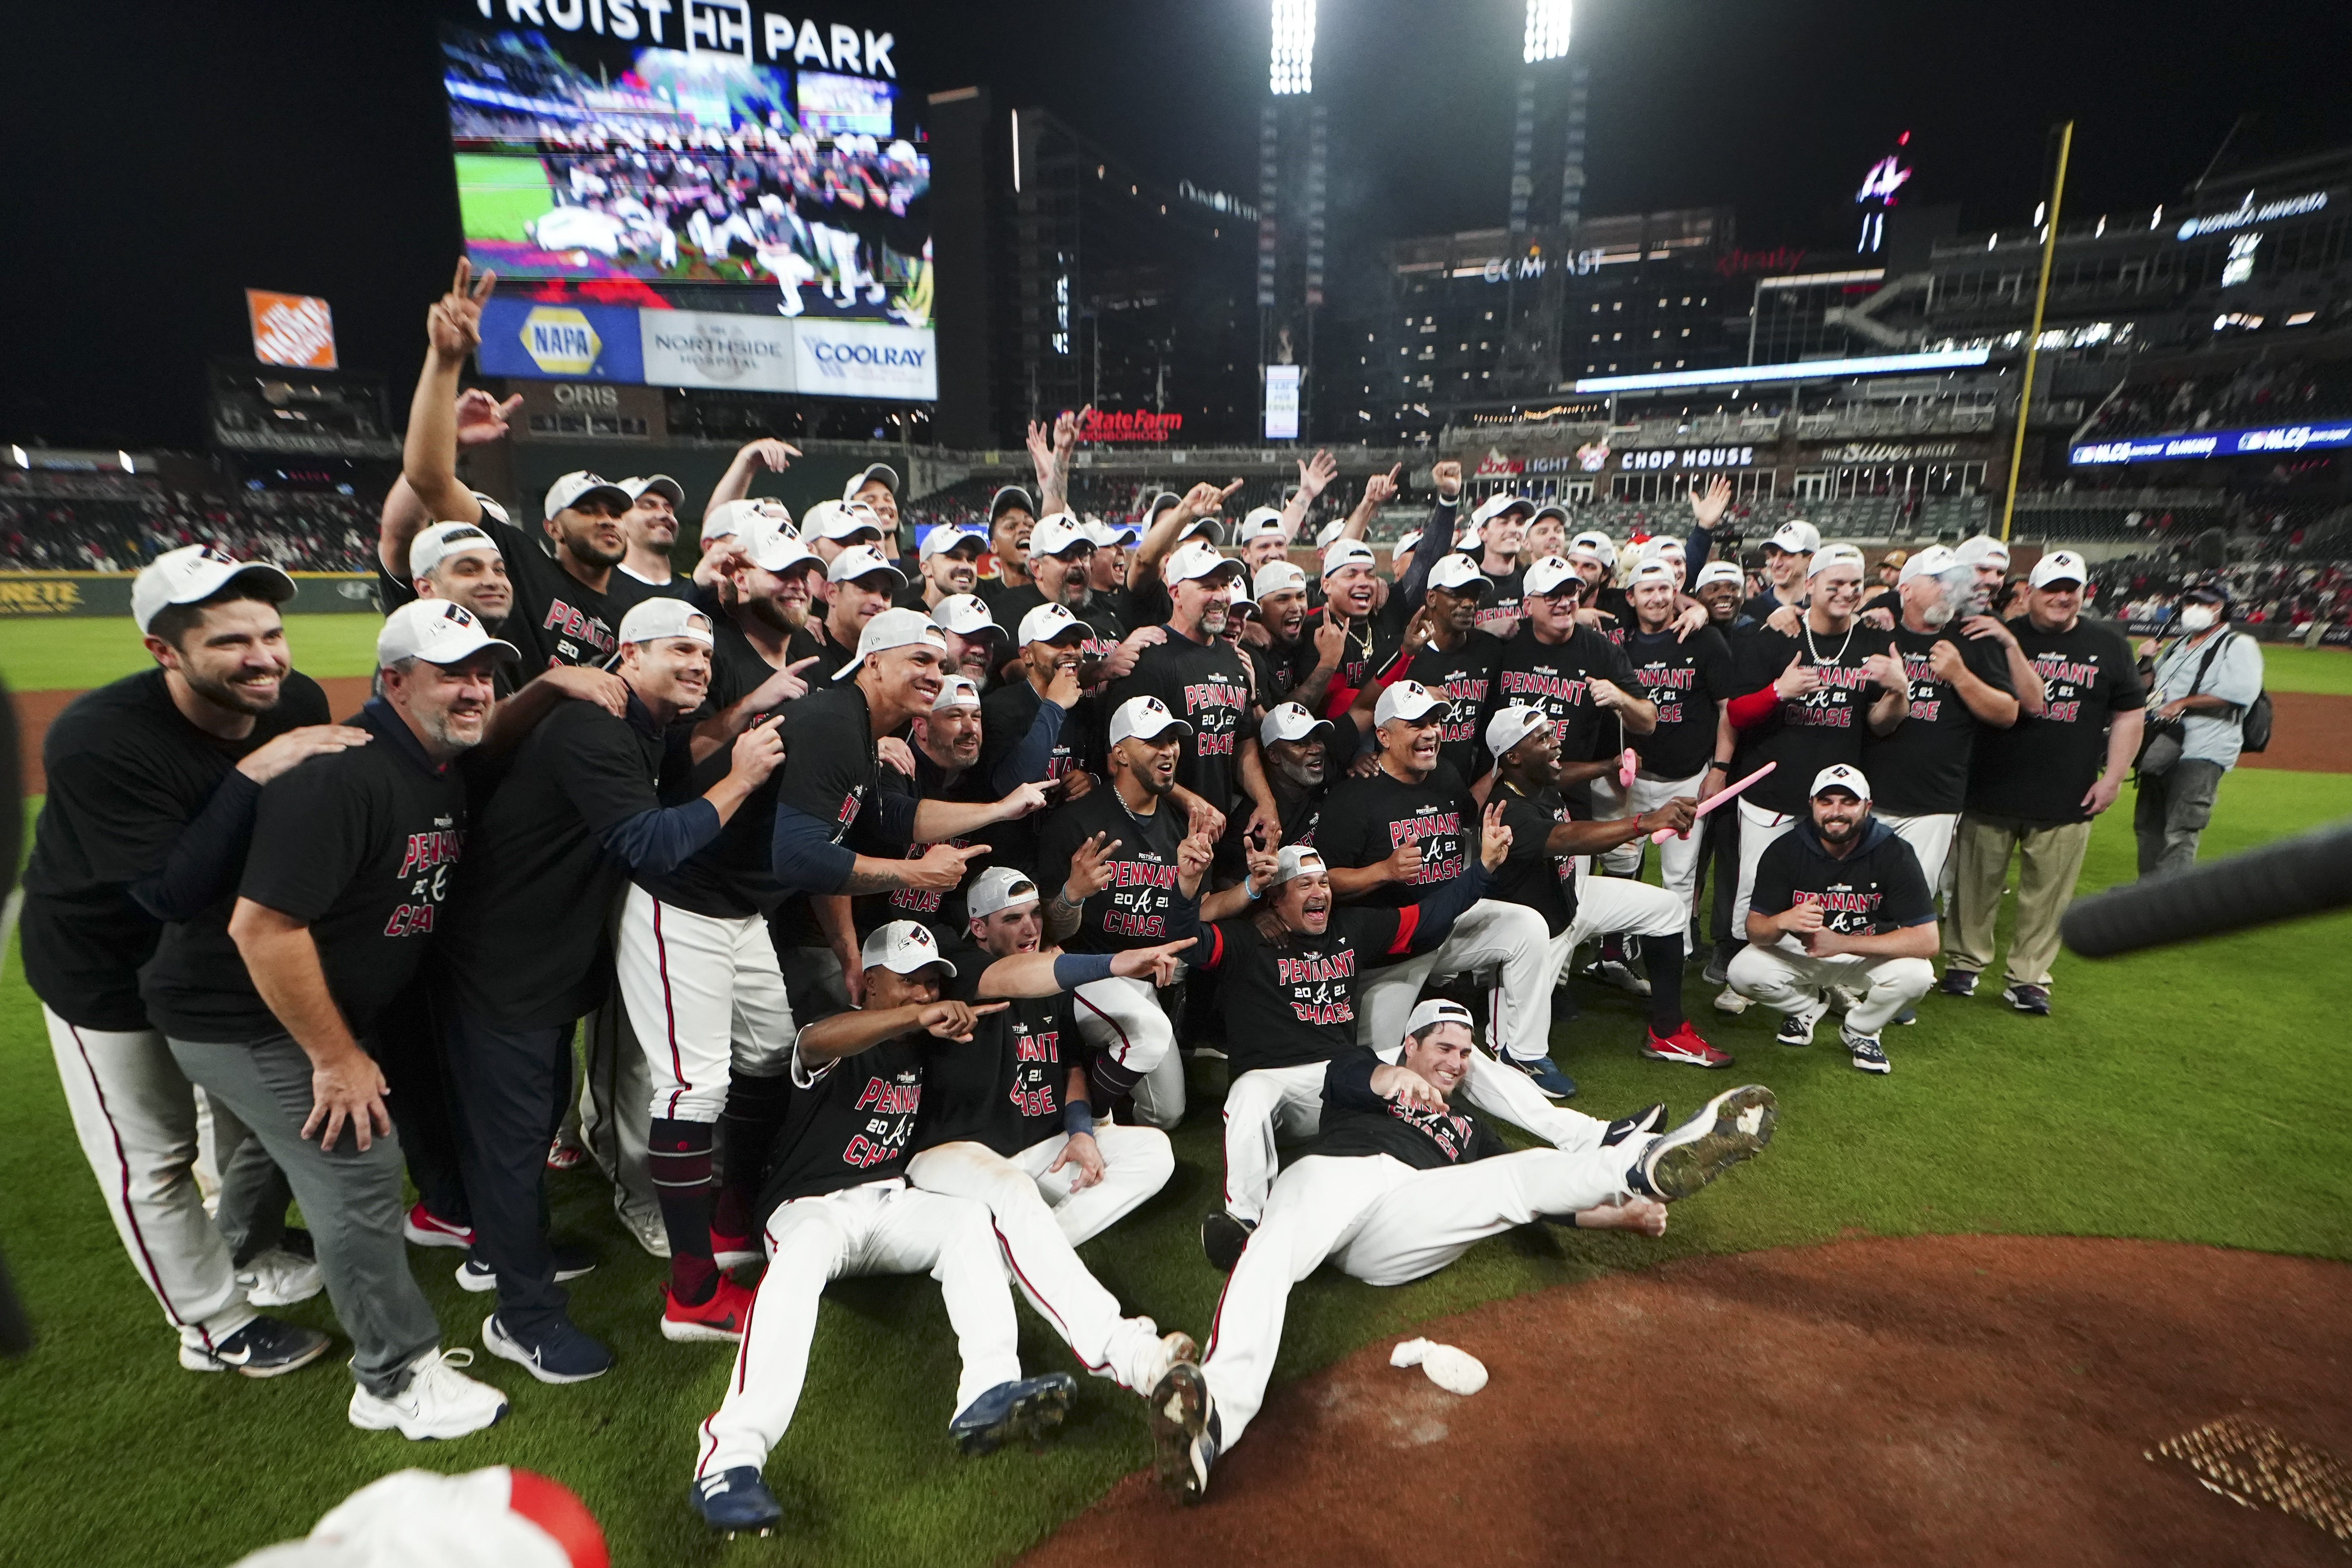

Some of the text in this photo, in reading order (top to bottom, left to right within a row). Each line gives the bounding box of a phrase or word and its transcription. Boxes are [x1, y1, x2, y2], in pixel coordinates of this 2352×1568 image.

[764, 12, 897, 78] PARK
[533, 324, 589, 356] NAPA
[655, 334, 781, 357] NORTHSIDE
[816, 342, 927, 368] COOLRAY
[1085, 408, 1182, 430] State Farm
[1477, 456, 1570, 474] Coors LIGHT
[1622, 447, 1753, 470] CHOP HOUSE
[557, 638, 579, 660] 20
[1500, 670, 1587, 707] PENNANT
[1634, 668, 1696, 691] NNANT
[1509, 696, 1525, 706] 20
[1550, 703, 1563, 715] 21
[1663, 691, 1677, 701] 21
[1832, 692, 1847, 703] 21
[1202, 714, 1215, 726] 20
[1225, 715, 1236, 725] 21
[1465, 705, 1476, 715] 21
[1785, 703, 1853, 728] CHASE
[1389, 812, 1464, 850] PENNANT
[1445, 841, 1457, 852] 21
[1114, 893, 1134, 905] 20
[1156, 896, 1169, 908] 21
[1852, 916, 1868, 926] 21
[1294, 987, 1312, 998] 20
[1334, 984, 1346, 997] 21
[1290, 995, 1354, 1025] CHASE
[1028, 1069, 1042, 1082] 21
[865, 1118, 888, 1136] 20
